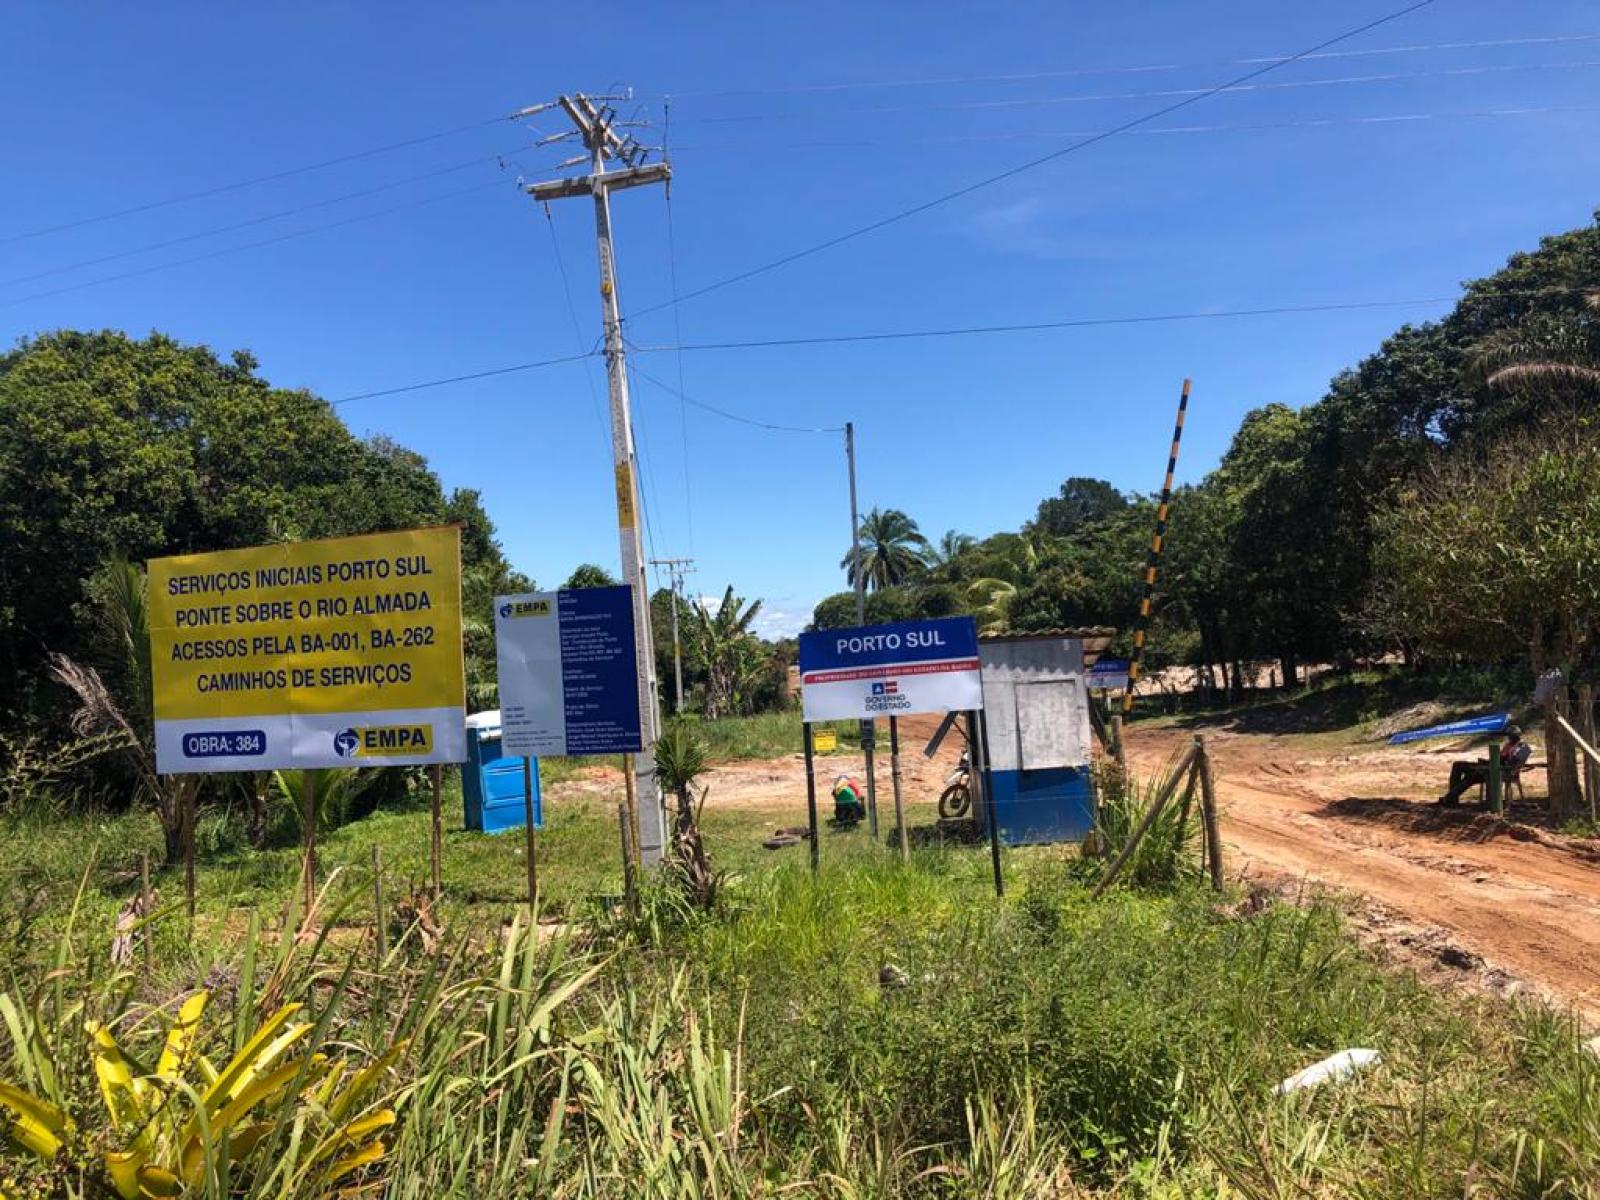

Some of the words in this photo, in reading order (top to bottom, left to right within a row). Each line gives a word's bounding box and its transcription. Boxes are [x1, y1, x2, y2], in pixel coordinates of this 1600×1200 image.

[168, 570, 251, 596] SERVIÇOS
[255, 564, 323, 588] INICIAIS
[327, 558, 390, 582] PORTO
[395, 555, 432, 577] SUL
[175, 605, 231, 628] PONTE
[235, 601, 293, 623] SOBRE
[298, 599, 312, 619] O
[317, 597, 348, 618] RIO
[353, 591, 432, 615] ALMADA
[516, 601, 548, 613] EMPA
[172, 638, 248, 661] ACESSOS
[252, 635, 296, 656] PELA
[301, 632, 365, 653] BA-001,
[371, 626, 434, 649] BA-262
[836, 634, 901, 655] PORTO
[905, 630, 947, 648] SUL
[197, 669, 287, 693] CAMINHOS
[292, 668, 315, 688] DE
[320, 663, 412, 688] SERVIÇOS
[188, 736, 232, 754] OBRA:
[236, 735, 260, 751] 384
[365, 727, 426, 748] EMPA
